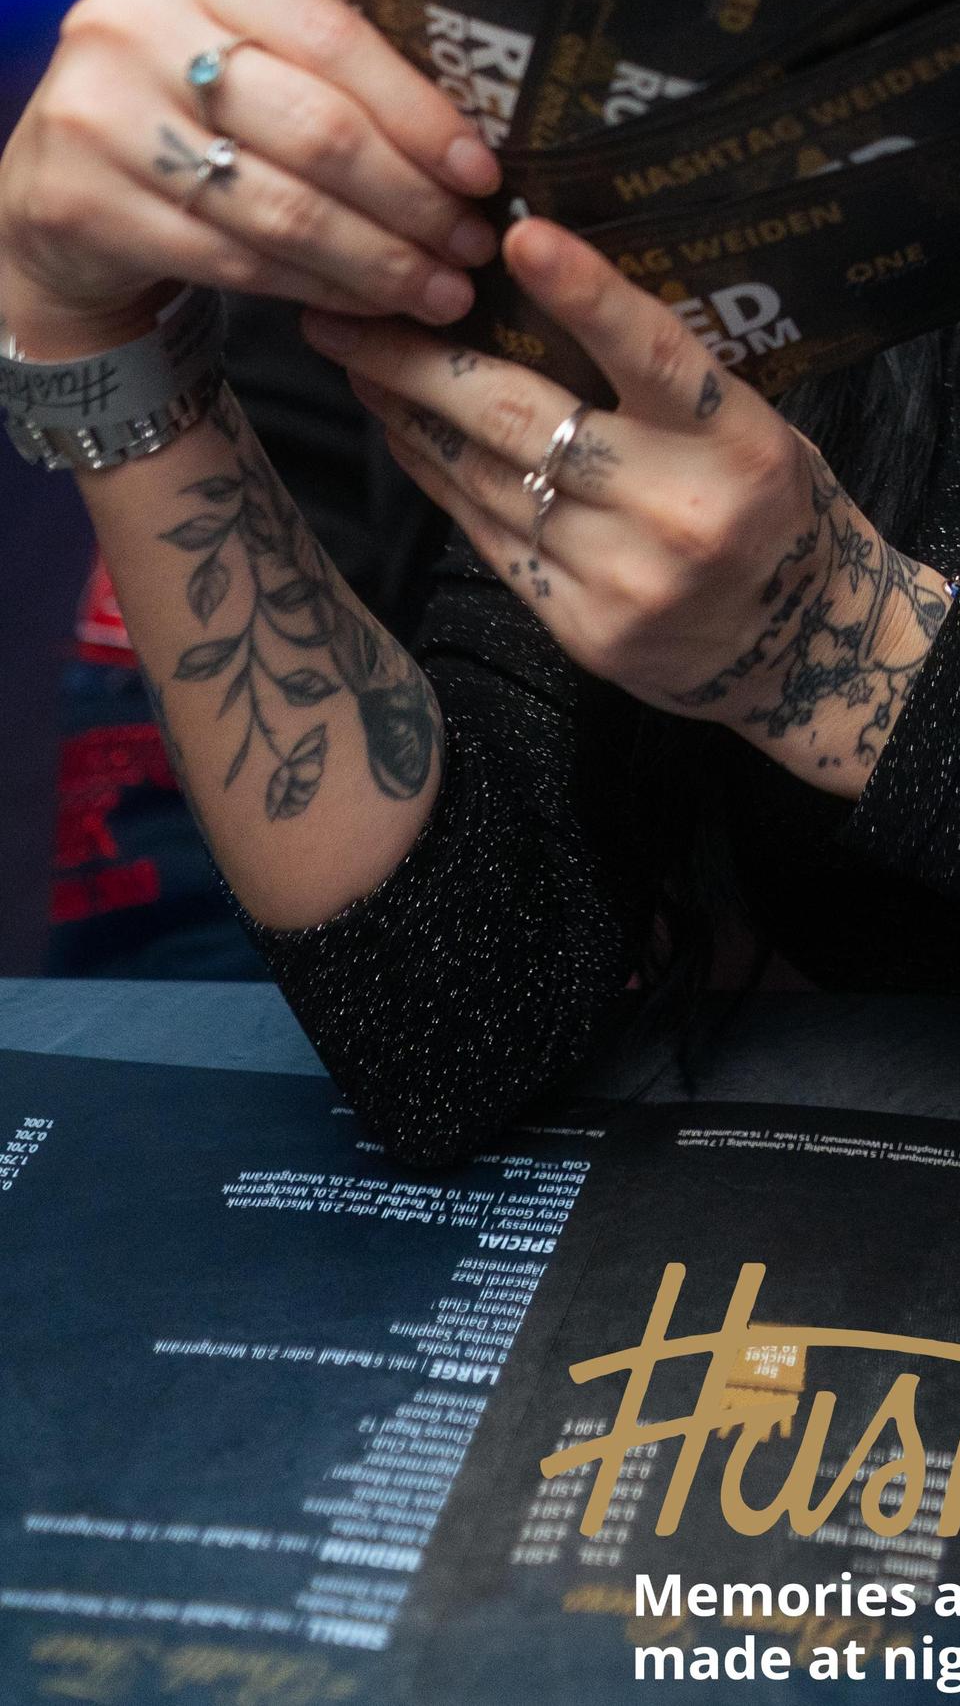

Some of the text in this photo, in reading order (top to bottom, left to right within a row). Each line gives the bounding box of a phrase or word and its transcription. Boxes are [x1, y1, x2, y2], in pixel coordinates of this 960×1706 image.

[613, 109, 806, 203] HASHTAG
[680, 201, 843, 264] WEIDEN
[845, 242, 926, 285] ONE
[23, 1117, 54, 1128] 1.00L
[15, 1129, 47, 1141] 0.70L
[726, 1138, 786, 1151] chininhaltig
[820, 1135, 881, 1149] Weizenmalz
[6, 1142, 39, 1153] 0.70L
[804, 1143, 868, 1157] koffeinhaltig
[904, 1144, 942, 1156] Hopfen
[503, 1156, 533, 1167] oder
[562, 1160, 591, 1172] Cola
[502, 1168, 586, 1184] Berliner Luft
[237, 1170, 575, 1209] Belvedere inkl. 10 oder 2.0L Mischgetränk
[537, 1184, 580, 1197] Ficken
[221, 1182, 569, 1222] Grey Goose inkl. 10 oder 2.0L Mischgetränk
[225, 1196, 564, 1235] Hennessy inkl. 6 oder 2.0L Mischgetränk
[478, 1232, 557, 1254] SPECIAL
[451, 1269, 539, 1291] Bacardi Razz
[479, 1287, 533, 1305] Bacardi
[438, 1296, 527, 1319] Havana Club
[435, 1313, 522, 1334] Jack Daniels
[389, 1320, 515, 1349] Bombay Sapphire
[152, 1338, 248, 1358] Mischgetränk
[280, 1345, 315, 1362] oder
[416, 1338, 460, 1358] Vodka
[464, 1346, 496, 1363] Mile
[388, 1356, 417, 1372] inkl.
[744, 1350, 797, 1366] Bucket
[428, 1358, 501, 1385] LARGE
[754, 1365, 779, 1379] 5er
[412, 1388, 487, 1413] Belvedere
[379, 1417, 420, 1438] Regal
[443, 1408, 480, 1429] Grey
[424, 1426, 473, 1445] Chivas
